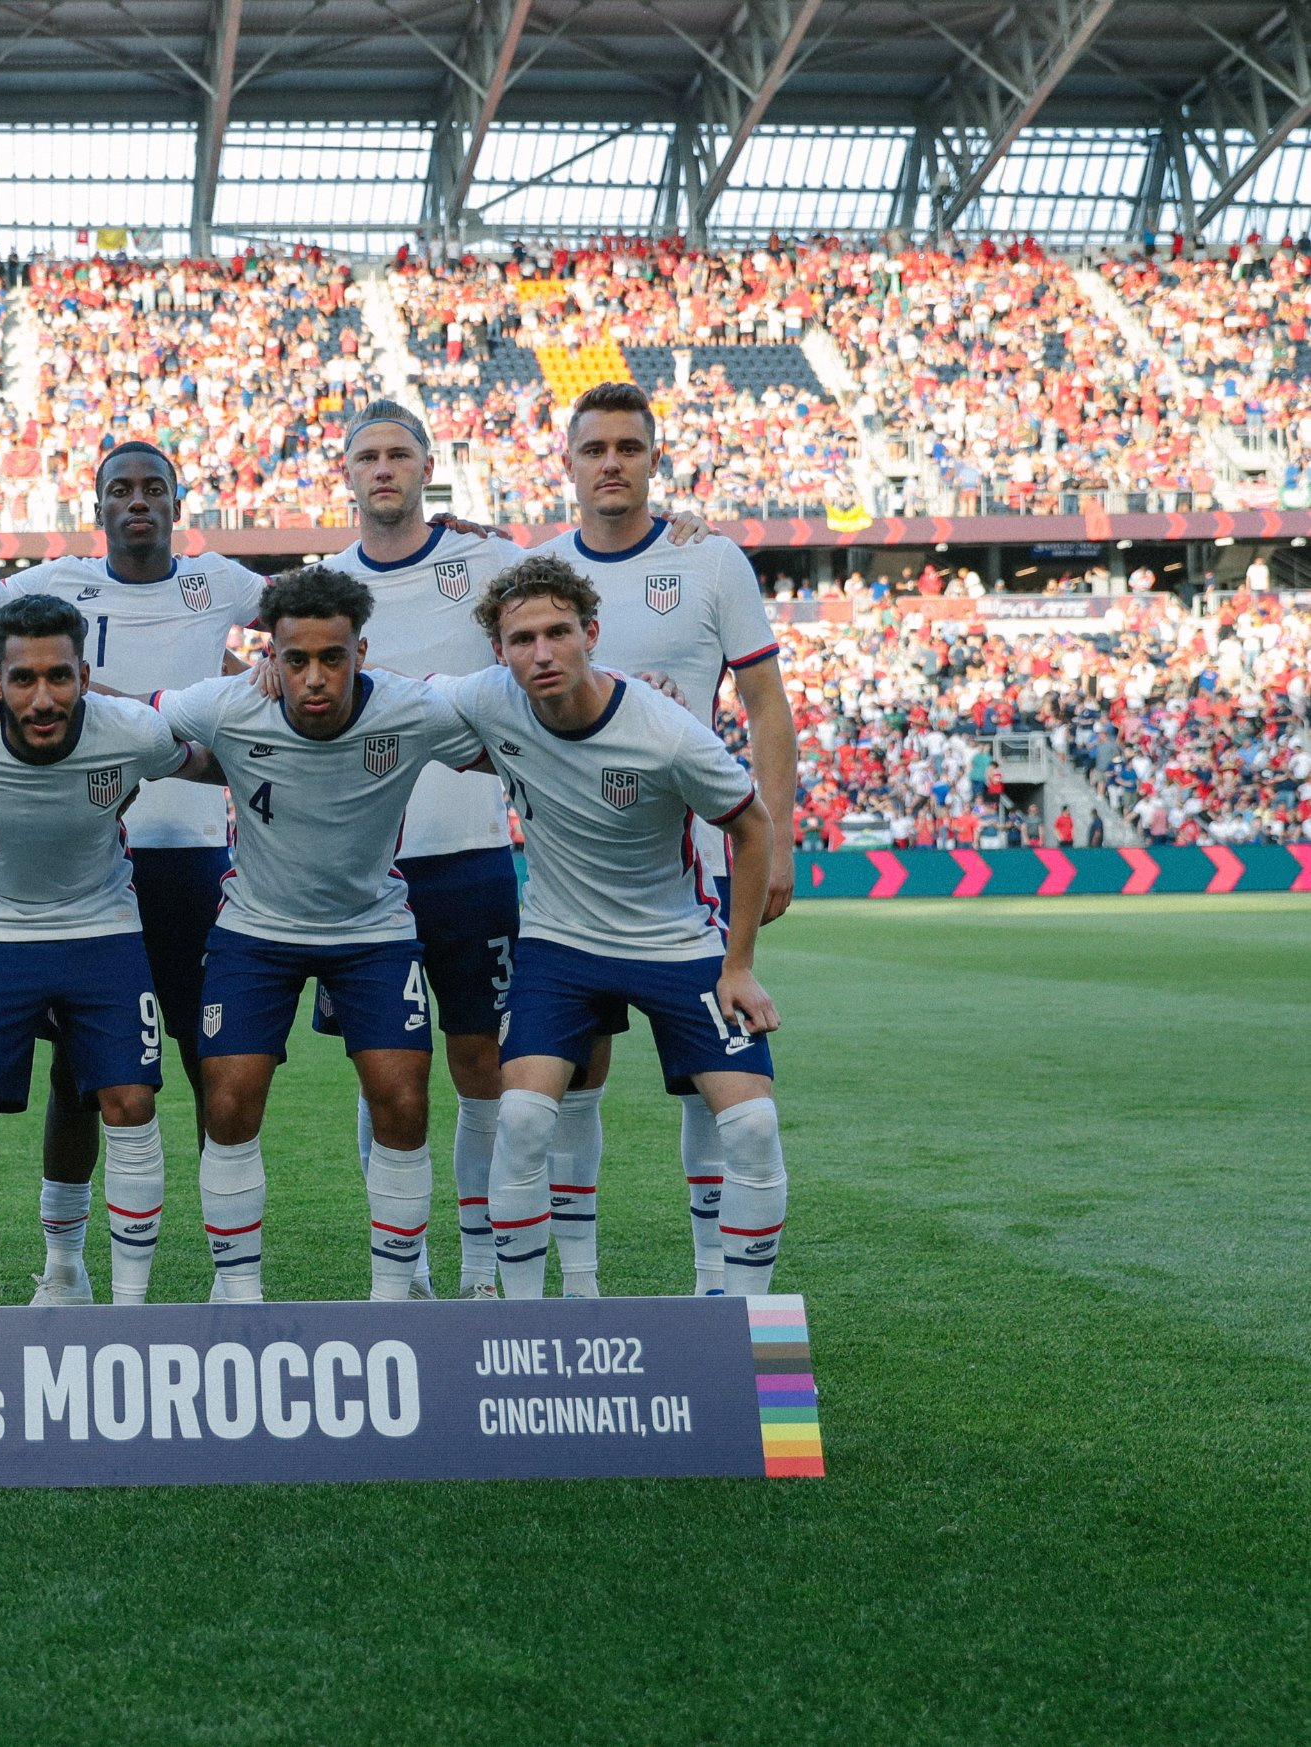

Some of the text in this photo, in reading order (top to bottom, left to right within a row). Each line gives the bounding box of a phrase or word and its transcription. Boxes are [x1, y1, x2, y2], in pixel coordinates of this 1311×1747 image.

[439, 563, 465, 579] USA
[82, 586, 102, 598] NIKE
[181, 576, 206, 592] USA
[650, 578, 677, 592] USA
[253, 744, 275, 754] NIKE
[369, 738, 396, 753] USA
[503, 741, 521, 755] NIKE
[91, 770, 118, 786] USA
[605, 772, 635, 788] USA
[249, 782, 274, 825] 4
[488, 936, 514, 991] 3
[403, 961, 426, 1012] 4
[139, 992, 160, 1046] 9
[204, 1006, 220, 1018] USA
[409, 1014, 425, 1024] NIKE
[730, 1037, 749, 1047] NIKE
[144, 1048, 159, 1057] NIKE
[213, 1240, 231, 1249] NIKE
[476, 1338, 644, 1378] JUNE 1, 2022
[24, 1340, 420, 1440] MOROCCO
[479, 1396, 691, 1436] CINCINNATI, OH
